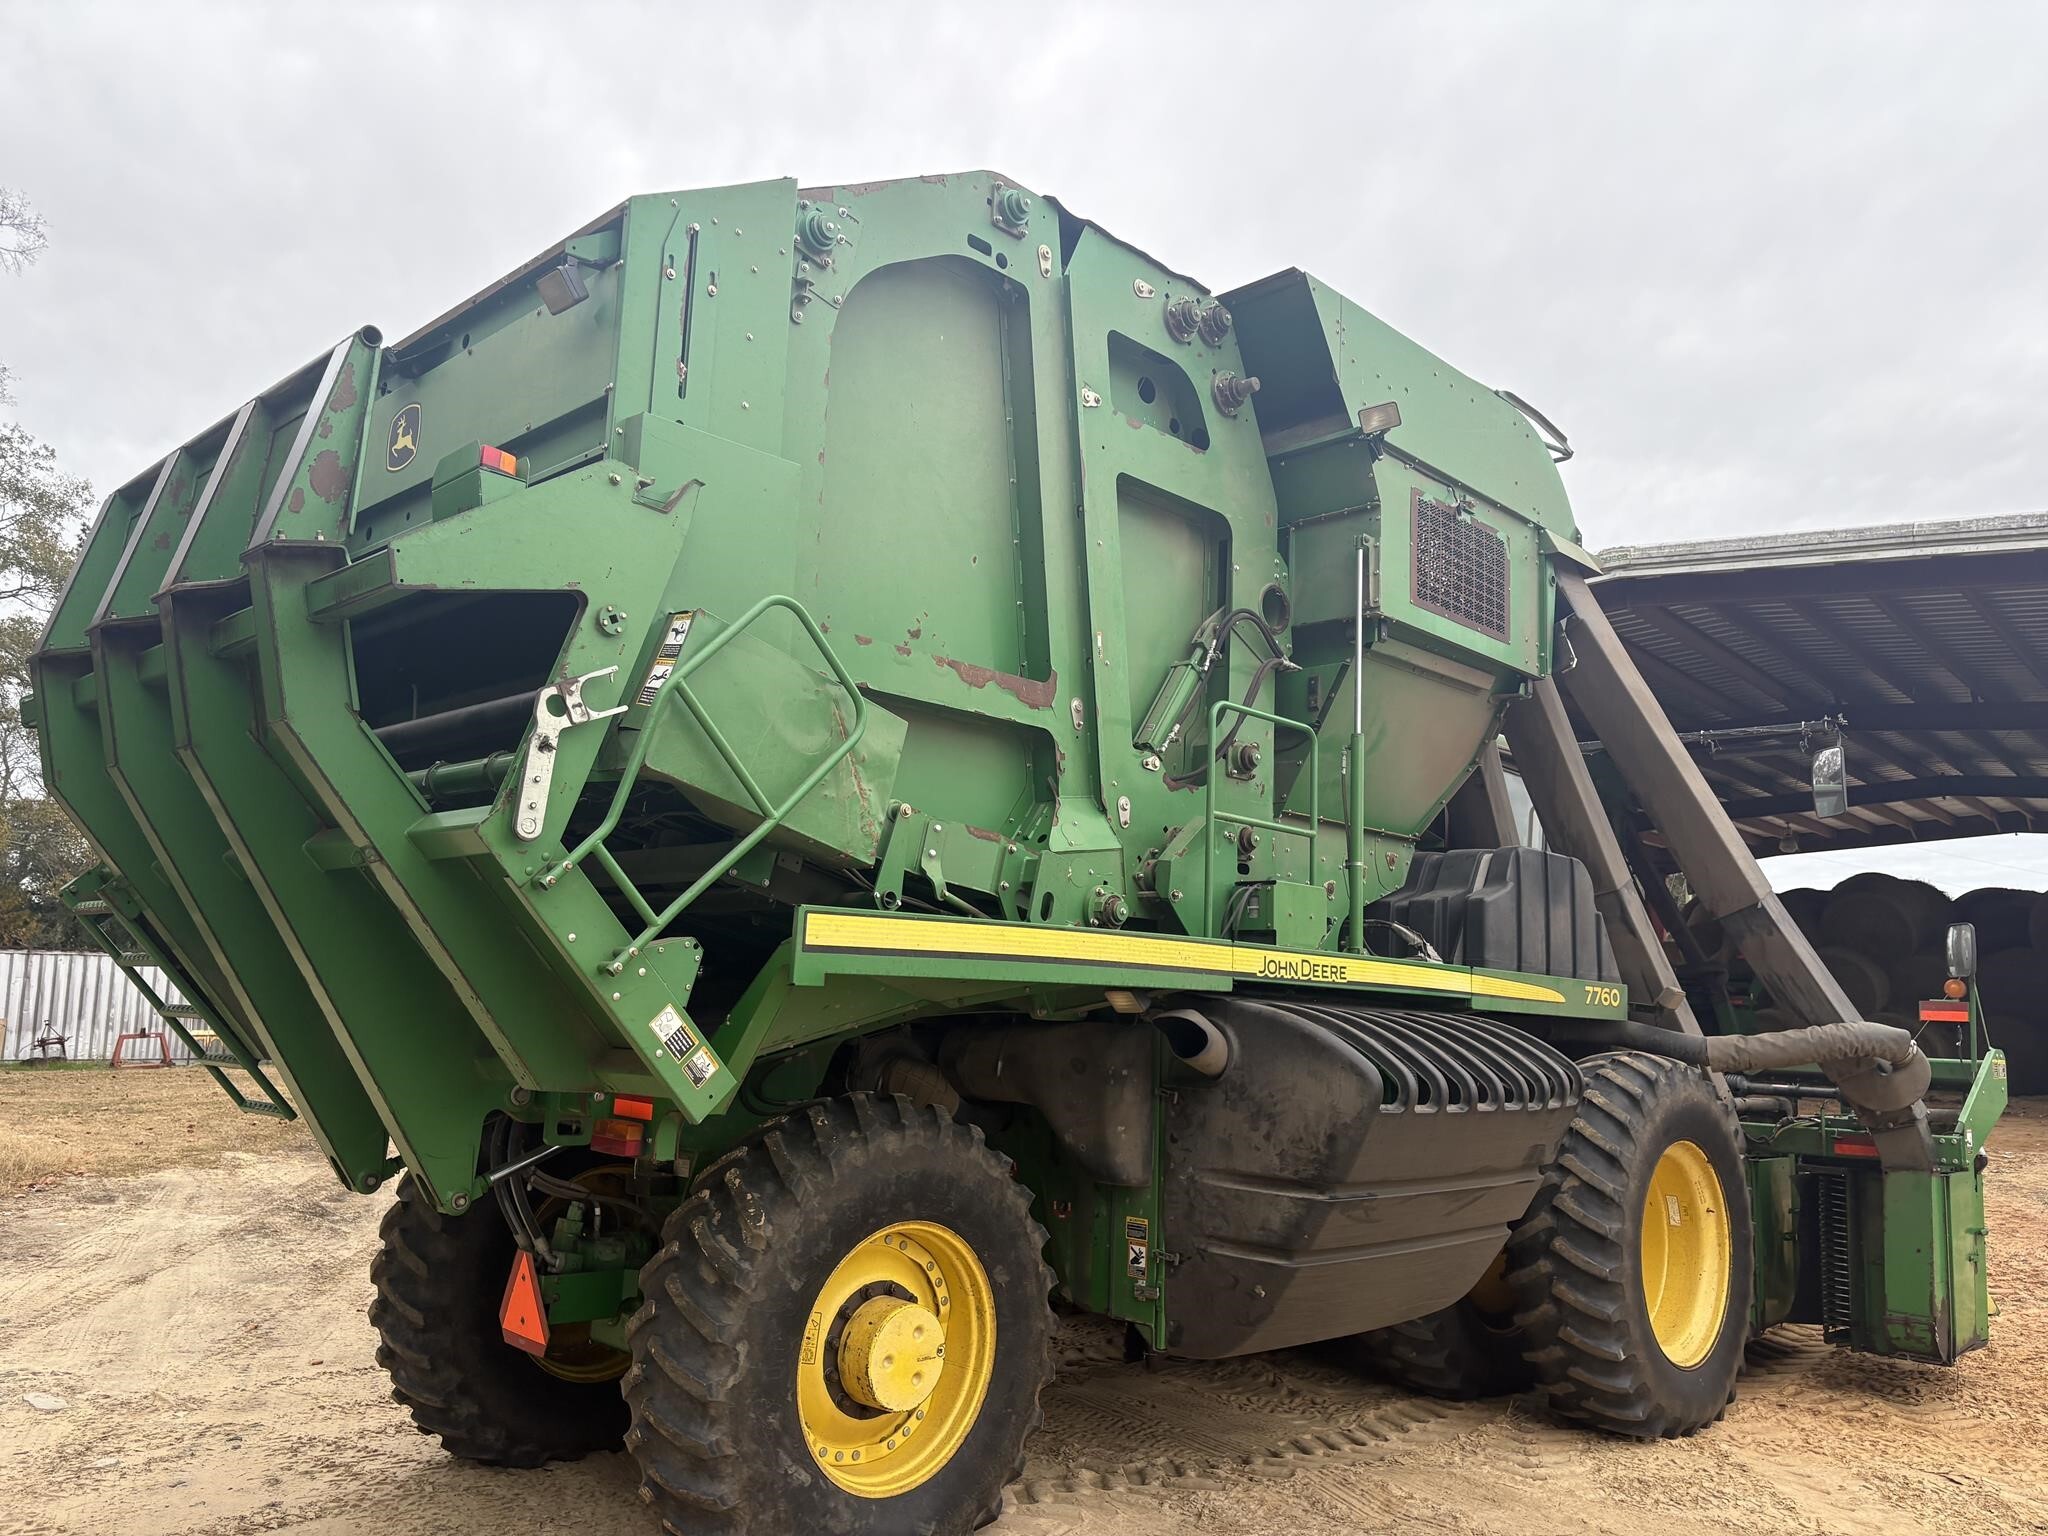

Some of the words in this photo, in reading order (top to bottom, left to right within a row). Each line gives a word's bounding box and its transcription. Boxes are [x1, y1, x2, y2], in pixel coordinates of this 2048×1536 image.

[1258, 955, 1298, 977] JOHN
[1301, 959, 1347, 980] DEERE
[1584, 985, 1620, 1007] 7760
